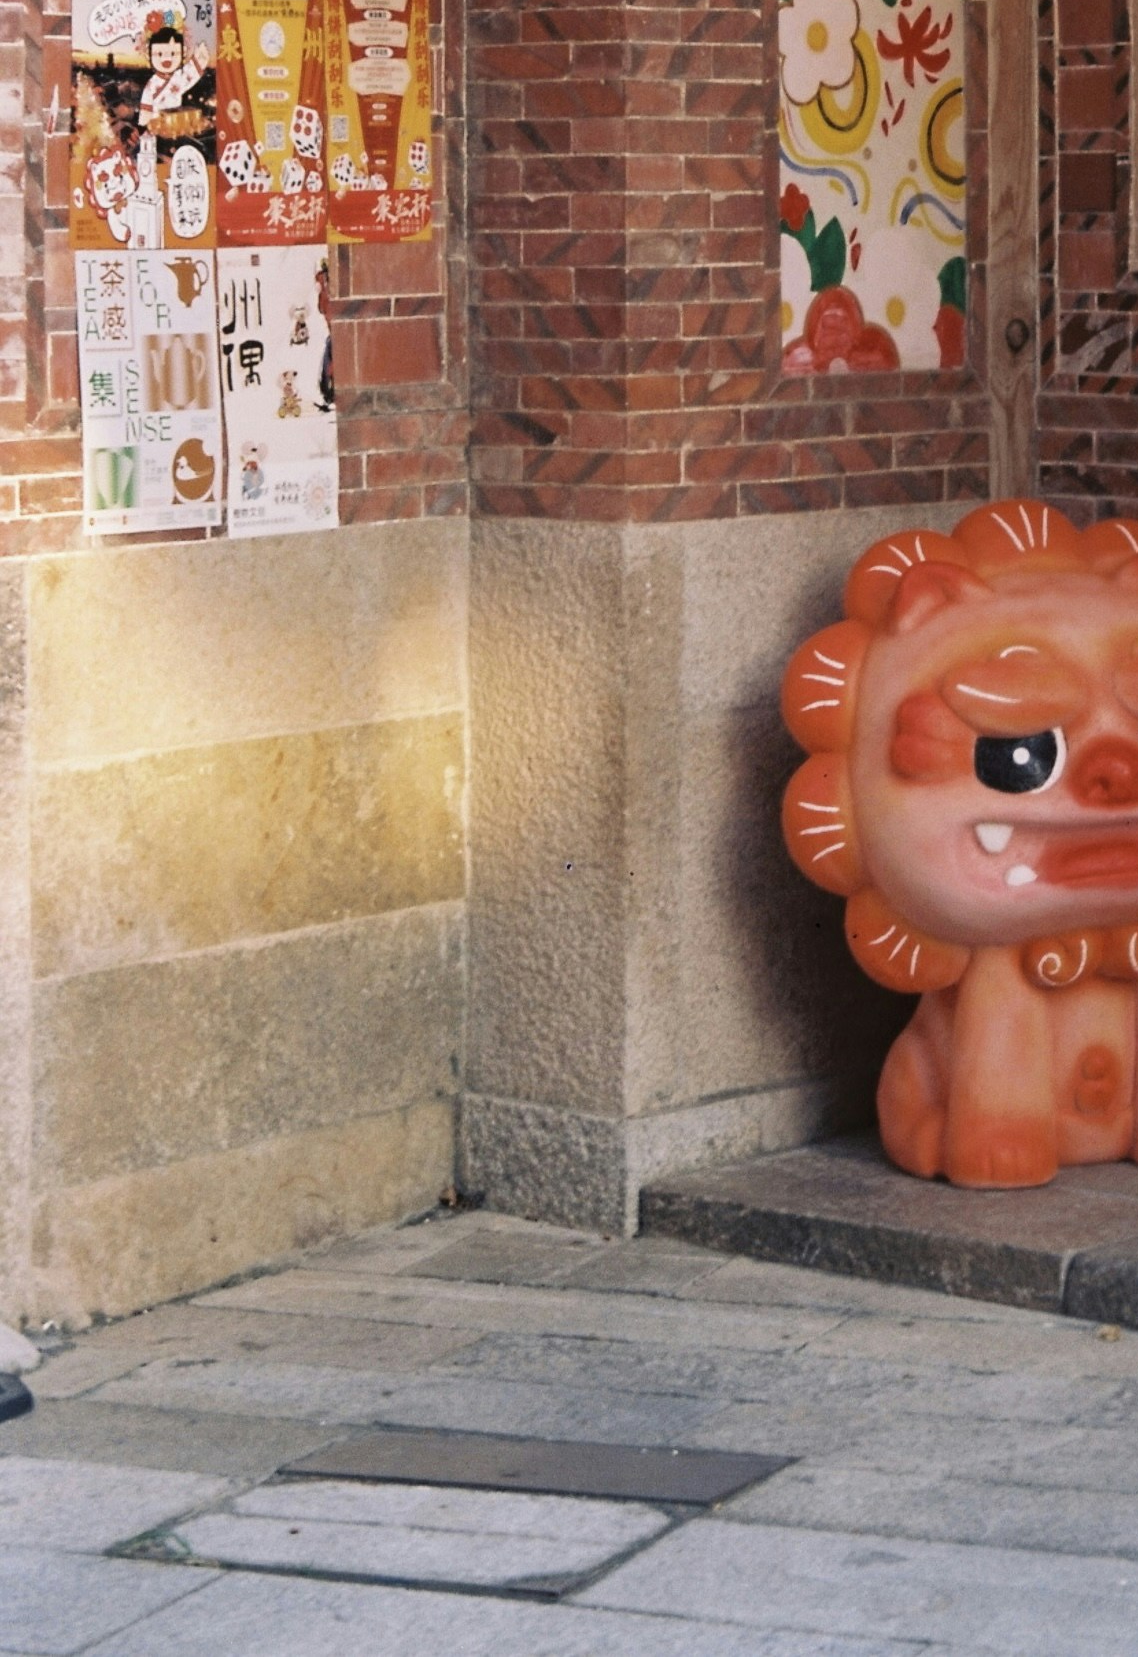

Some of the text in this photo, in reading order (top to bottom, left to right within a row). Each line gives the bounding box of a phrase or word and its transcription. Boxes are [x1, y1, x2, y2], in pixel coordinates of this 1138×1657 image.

[219, 24, 243, 62] 泉
[136, 259, 171, 329] FOR
[88, 369, 116, 408] 集
